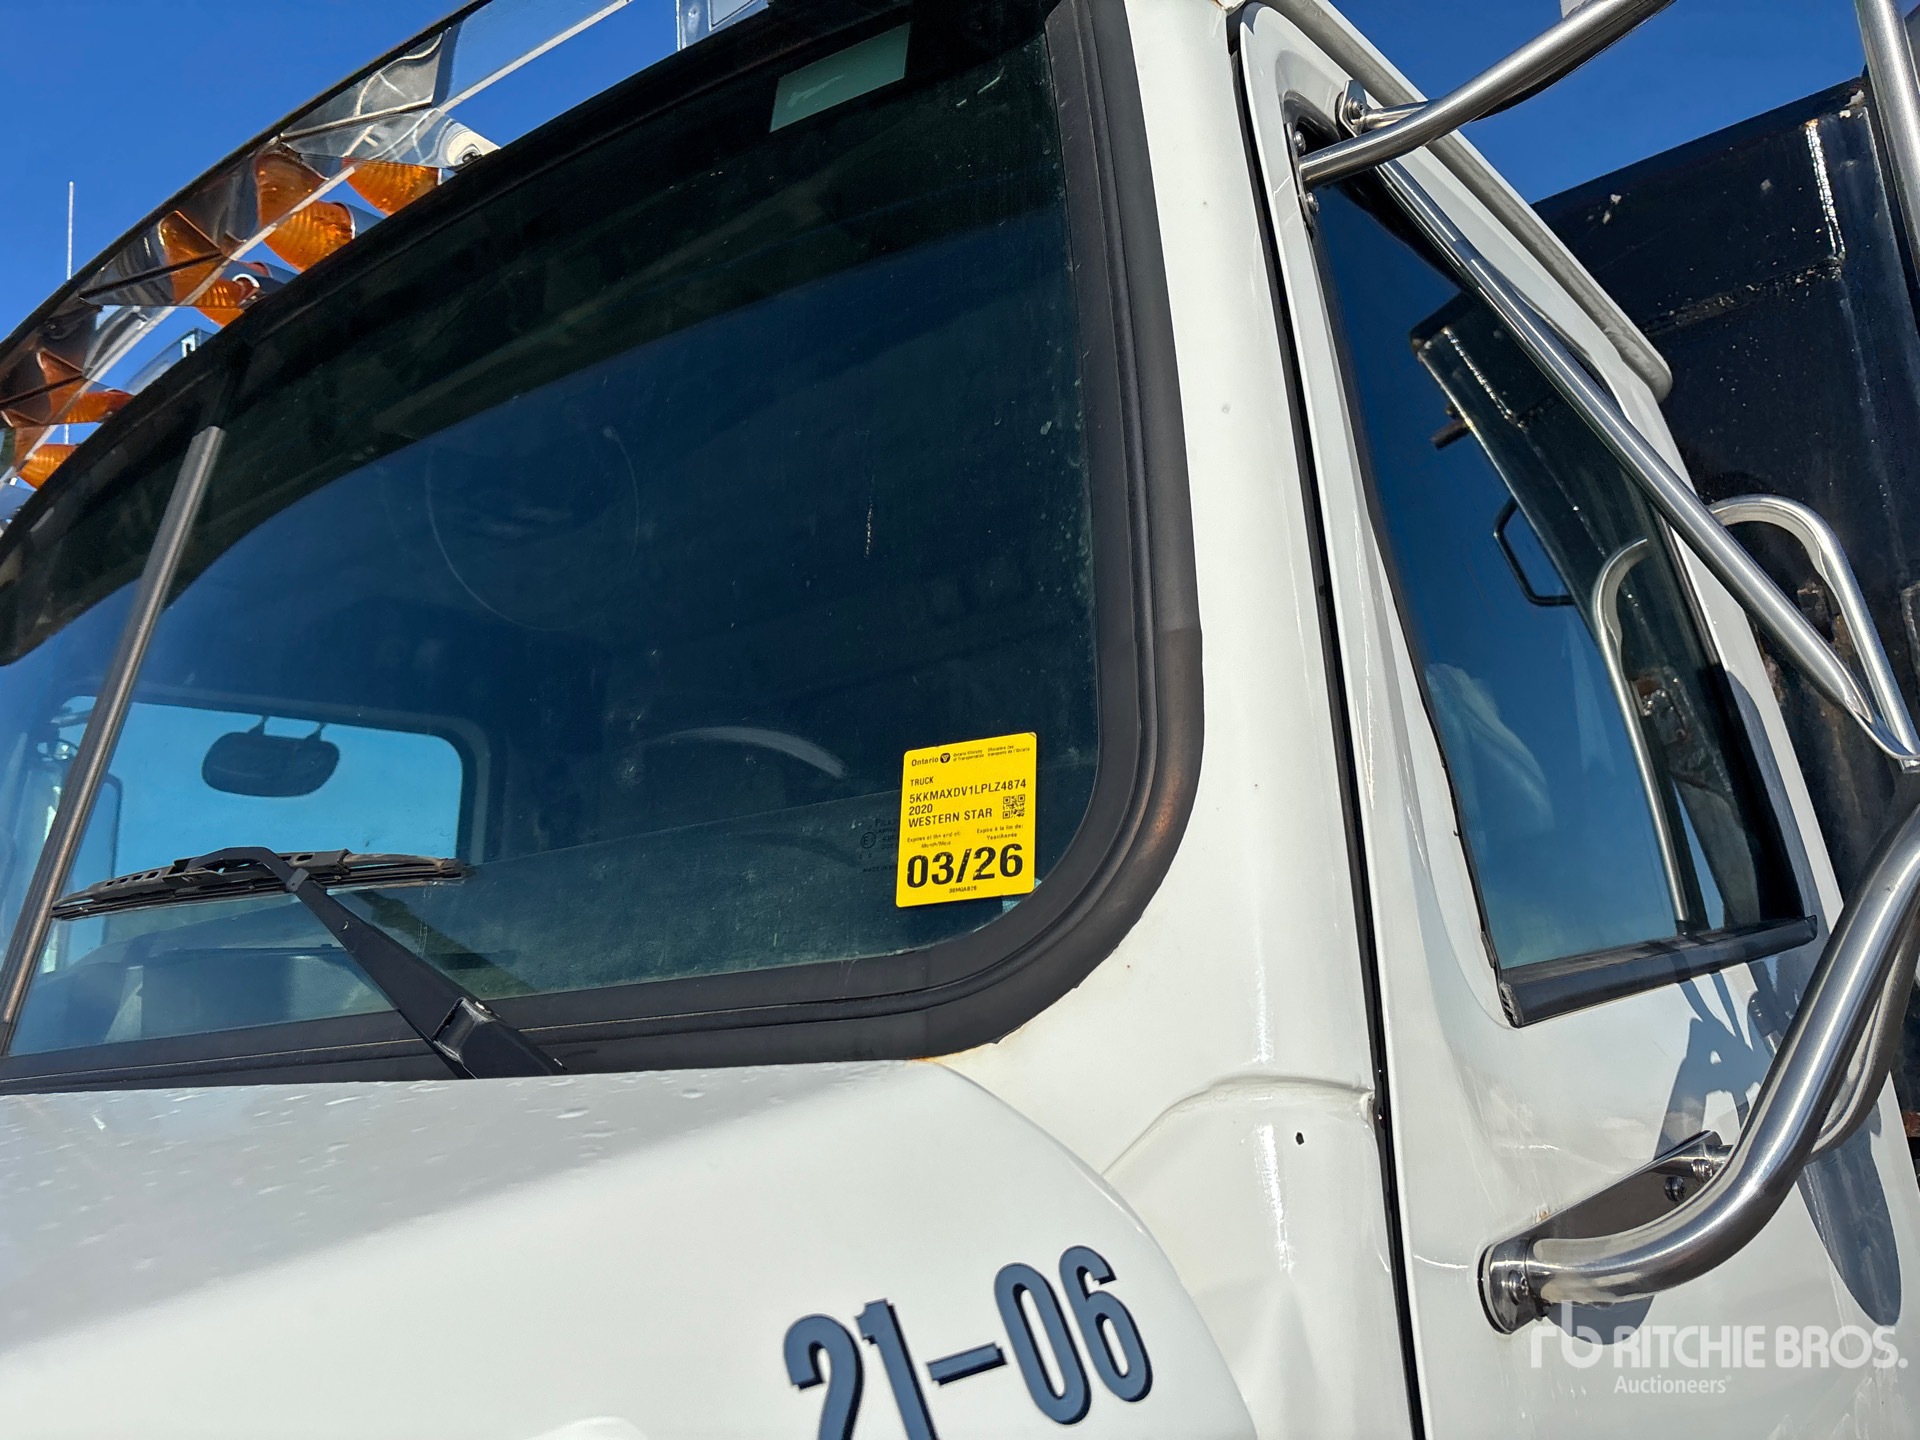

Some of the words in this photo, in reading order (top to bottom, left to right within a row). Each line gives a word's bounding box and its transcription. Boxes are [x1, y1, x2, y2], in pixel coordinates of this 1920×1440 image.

[911, 756, 939, 767] Ontario
[909, 778, 1027, 804] 5KKMAXDV1LPLZ4874
[910, 776, 934, 787] TRUCK
[908, 803, 933, 816] 2020
[908, 812, 960, 828] WESTERN
[964, 807, 993, 820] STAR
[906, 843, 1024, 889] 03/26
[783, 1245, 1153, 1440] 21-06
